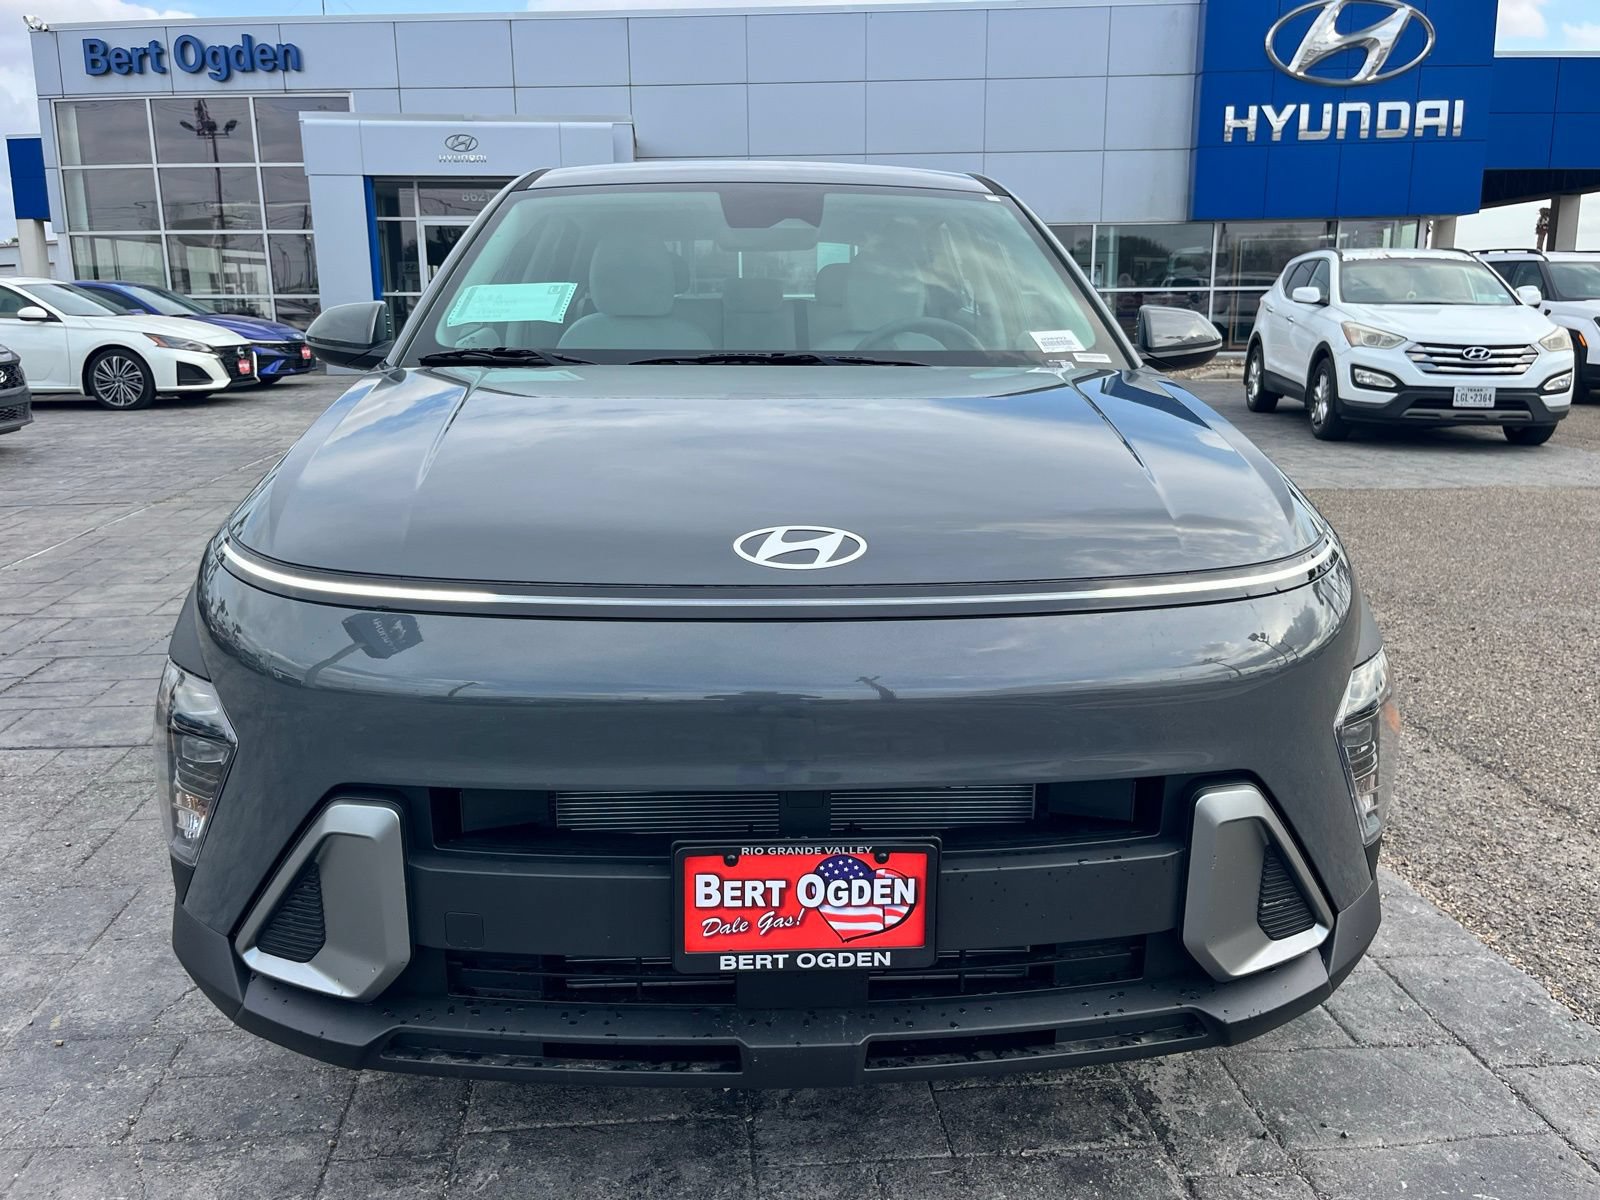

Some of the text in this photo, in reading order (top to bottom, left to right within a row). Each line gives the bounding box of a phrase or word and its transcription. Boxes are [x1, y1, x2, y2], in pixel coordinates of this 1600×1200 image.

[82, 33, 302, 82] Bert Ogden
[1223, 99, 1465, 142] HYUNDAI
[438, 154, 487, 163] HYUNDAI
[741, 846, 873, 856] RIO GRANDE VALLEY
[695, 873, 915, 908] BERT OGDEN
[701, 908, 805, 938] Dale Gas!
[719, 951, 891, 971] BERT OGDEN
